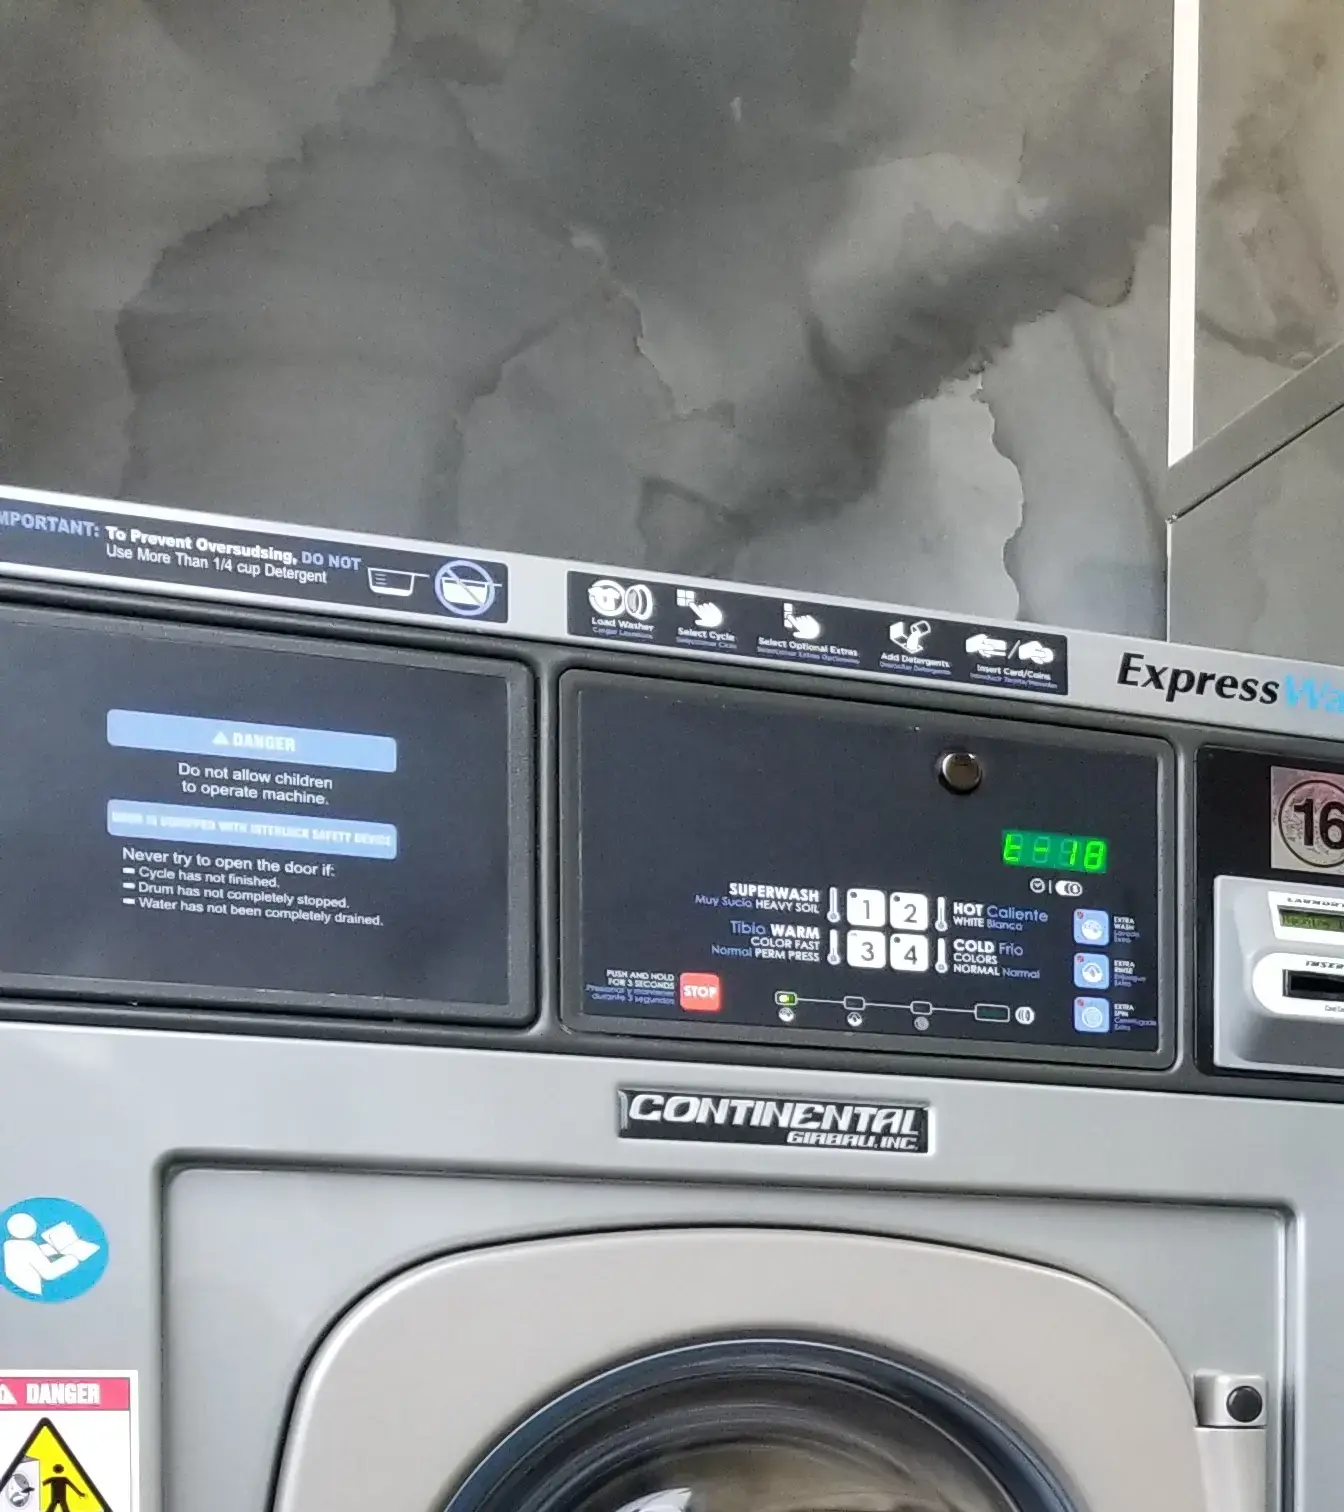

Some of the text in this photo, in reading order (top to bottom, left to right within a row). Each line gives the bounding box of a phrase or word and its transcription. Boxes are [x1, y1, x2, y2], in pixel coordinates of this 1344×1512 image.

[0, 512, 362, 571] MPORTANT: To Prevent Oversudsing, DO NOT
[106, 543, 328, 584] Use More Than 1/4 cup Detergent
[591, 617, 616, 628] Load
[678, 627, 735, 642] Select Cycle
[758, 637, 787, 649] Select
[789, 639, 827, 655] Optional
[829, 645, 858, 656] Extras
[881, 652, 900, 662] Add
[902, 654, 950, 669] Detergents
[233, 732, 296, 752] DANGER
[178, 762, 333, 790] Do not allow children
[182, 779, 329, 806] to operate machine.
[122, 847, 335, 877] Never try to open the door if:
[139, 866, 280, 888] Cycle has not finished.
[139, 882, 349, 909] Drum has not completely stopped.
[729, 882, 820, 902] SUPERWASH
[139, 897, 383, 927] Water has not been completely drained.
[695, 894, 820, 914] Muy Sucio HEAVY SOIL
[862, 900, 917, 923] 1 2
[952, 901, 1049, 923] HOT Caliente
[730, 920, 820, 939] Tibio WARM
[952, 915, 1024, 931] WHITE Blanco
[712, 943, 820, 962] Normal PERM PRESS
[750, 936, 820, 950] COLOR FAST
[860, 942, 918, 964] 3 4
[953, 938, 994, 954] COLD
[953, 951, 998, 965] COLORS
[953, 963, 1040, 979] NORMAL Normal
[683, 985, 717, 998] STOP
[628, 1094, 920, 1136] CONTINENTAL
[26, 1383, 100, 1404] DANGER
